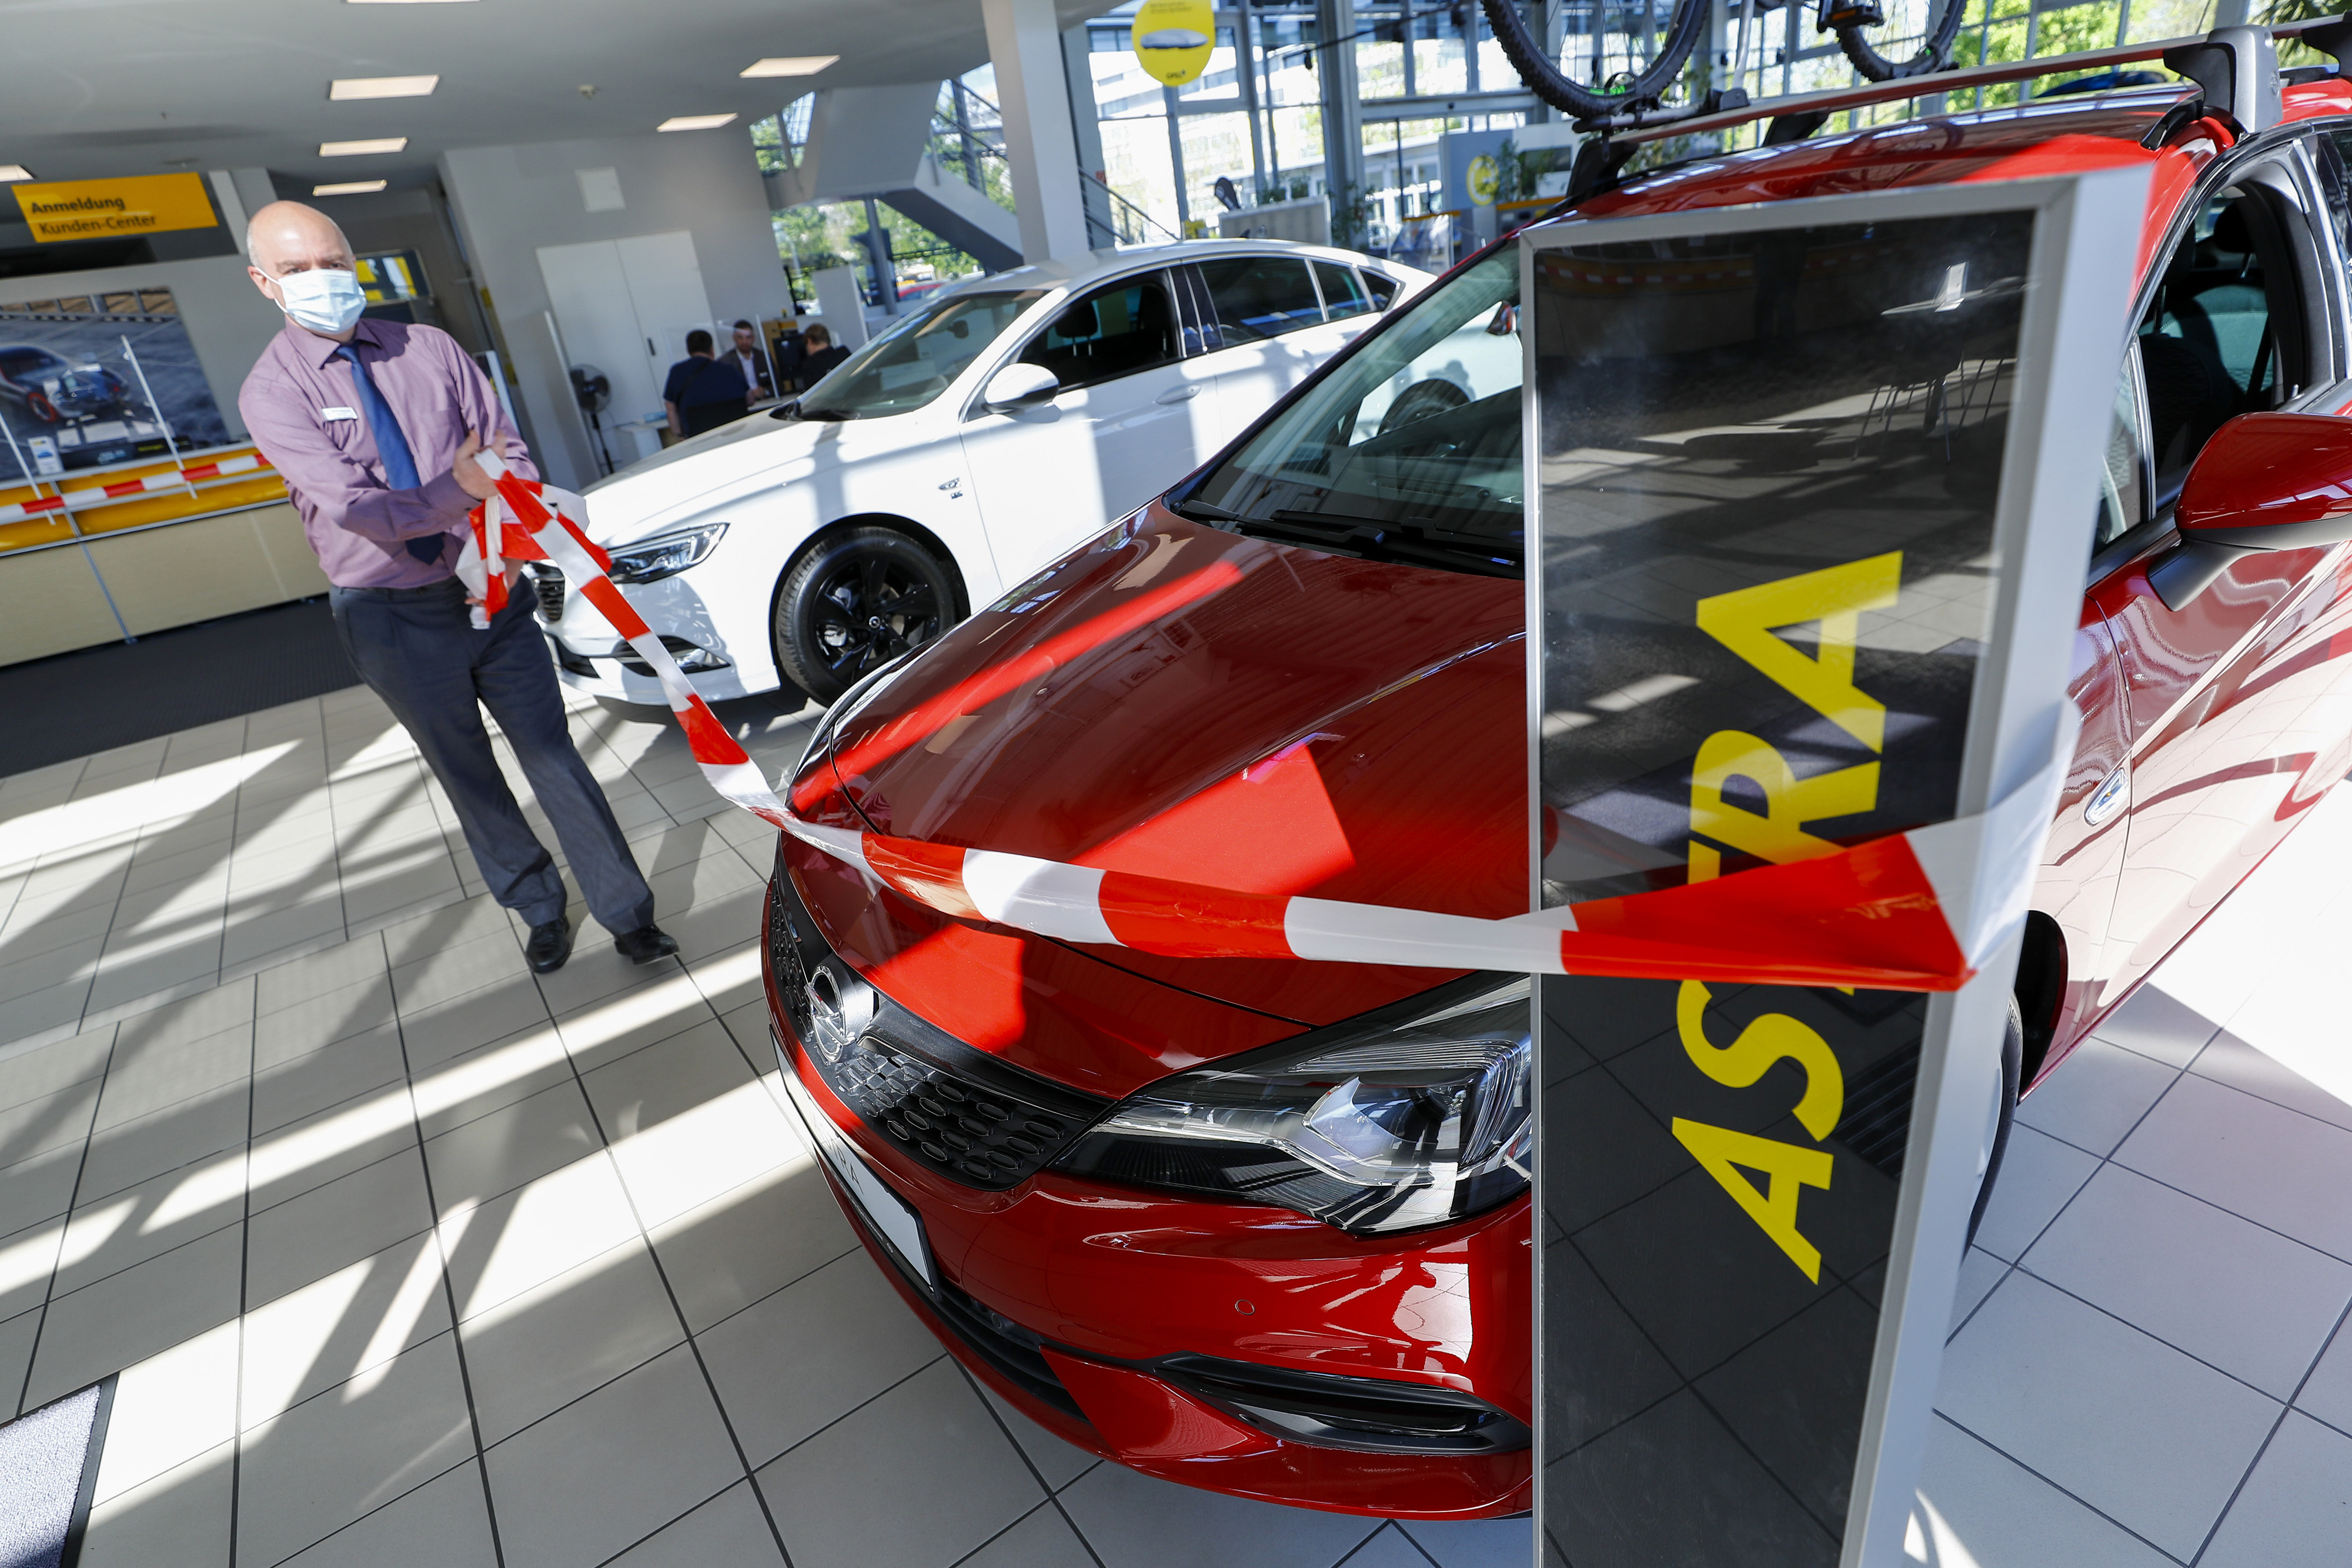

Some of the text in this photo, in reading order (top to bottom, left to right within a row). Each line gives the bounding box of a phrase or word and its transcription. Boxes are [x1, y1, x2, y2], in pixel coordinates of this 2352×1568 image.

[32, 198, 125, 213] Anmeldung
[39, 216, 156, 234] Kunden-Center
[1672, 550, 1903, 1285] ASRA
